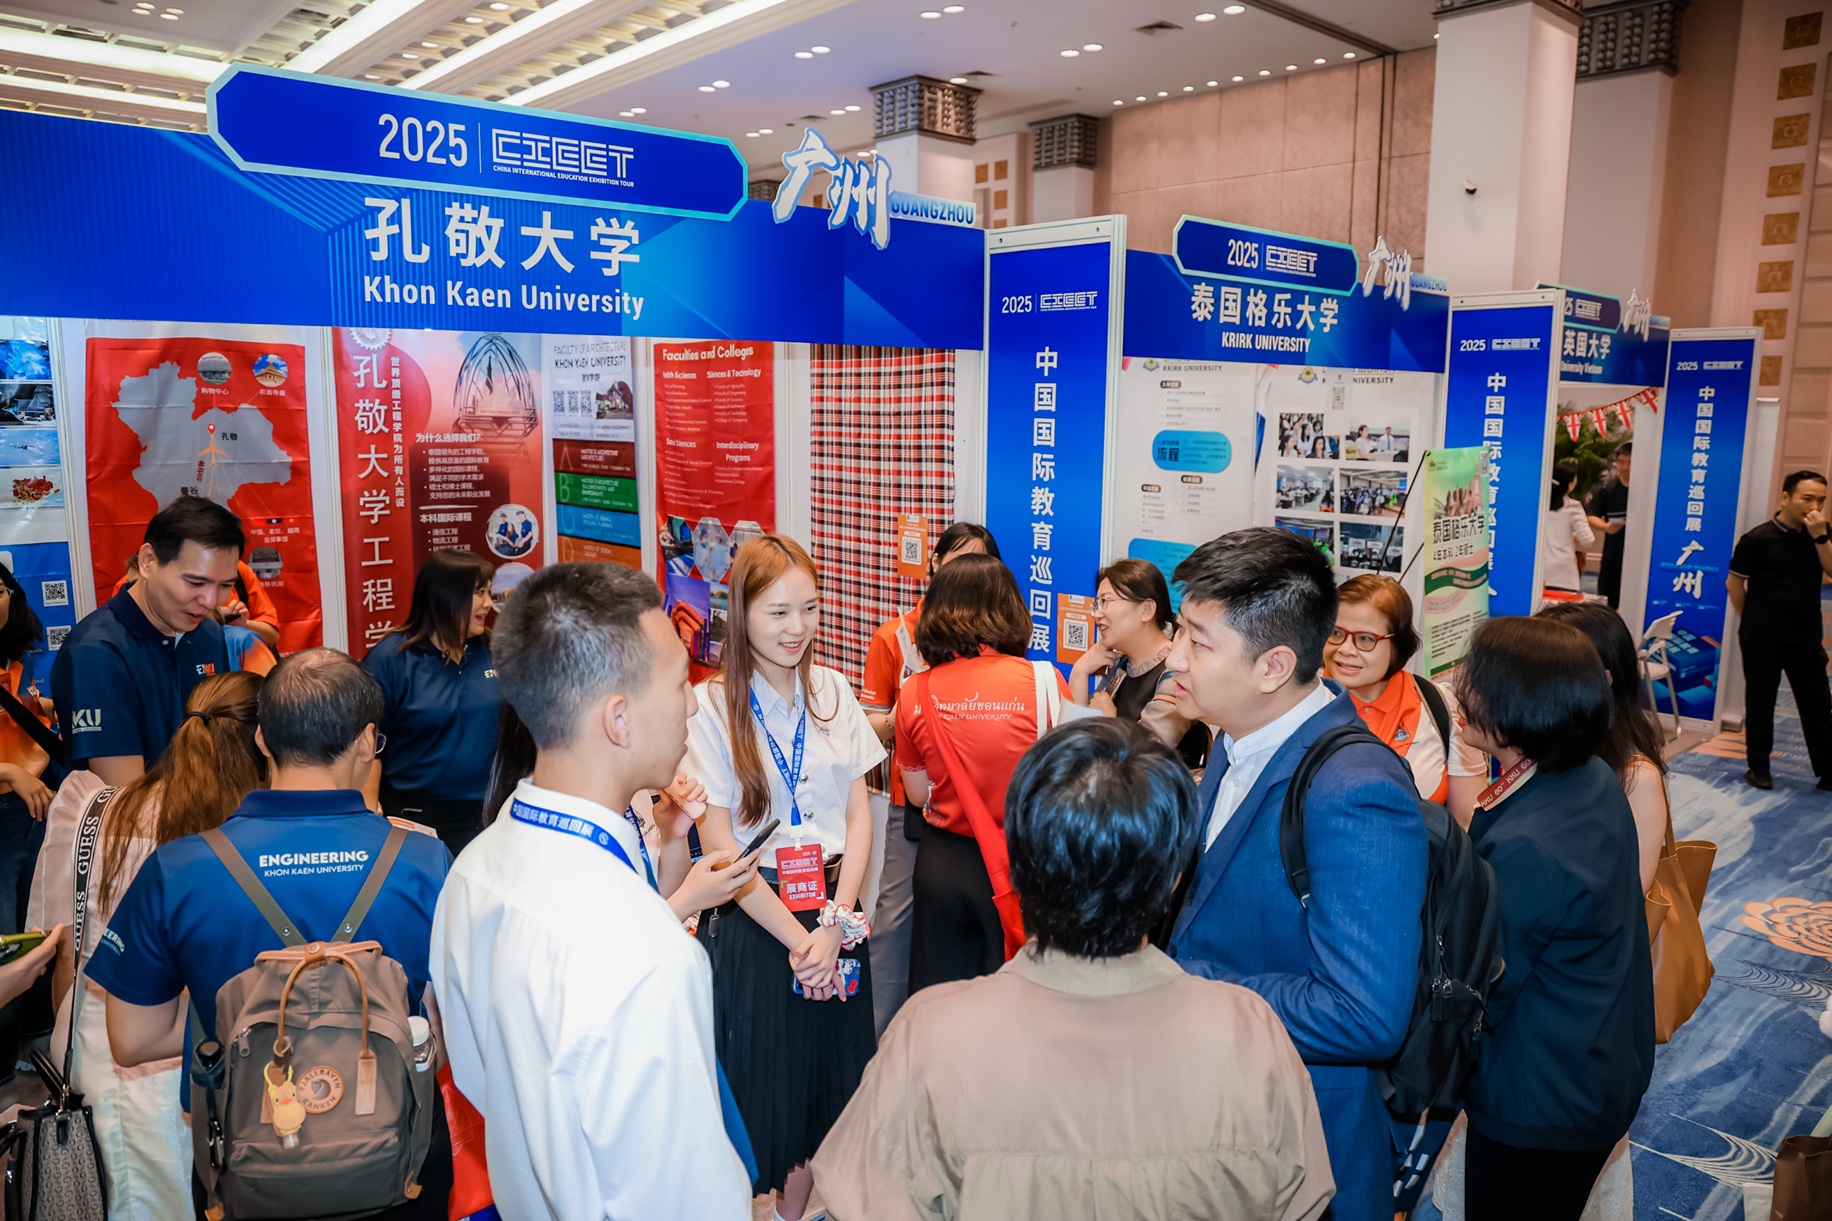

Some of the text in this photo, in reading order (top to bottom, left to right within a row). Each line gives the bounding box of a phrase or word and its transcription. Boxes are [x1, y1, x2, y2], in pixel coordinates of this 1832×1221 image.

[378, 113, 634, 178] 2025 CIEET
[493, 165, 635, 188] CHINA INTERNATIONAL EDUCATION EXHIBITION TOUR
[773, 128, 892, 249] 广州
[891, 195, 975, 225] GUANGZHOU
[364, 197, 640, 276] 孔敬大学
[1227, 239, 1259, 269] 2025
[1363, 236, 1412, 311] 广州
[364, 275, 644, 321] Khon Kaen University
[1001, 295, 1033, 314] 2025
[1190, 282, 1339, 333] 泰国格乐大学
[700, 346, 715, 360] and
[717, 344, 754, 360] Colleges
[1222, 332, 1311, 353] KRIRK UNIVERSITY
[1459, 339, 1487, 352] 2025
[590, 355, 627, 367] UNIVERSITY
[1352, 376, 1395, 384] NIVERSITY
[390, 356, 405, 508] 世界顶级工程学院为所有人而设
[726, 454, 751, 463] Programs
[1685, 386, 1715, 532] 中国国际教育巡回展
[1028, 346, 1058, 653] 中国国际教育巡回展
[1673, 540, 1705, 599] 广州
[1505, 769, 1520, 784] KKU
[78, 816, 99, 874] GUESS
[259, 850, 369, 868] ENGINEERING
[264, 864, 364, 877] KHON KAEN UNIVERSITY
[787, 881, 818, 894] 展商证
[789, 892, 816, 900] EXHIBITOR
